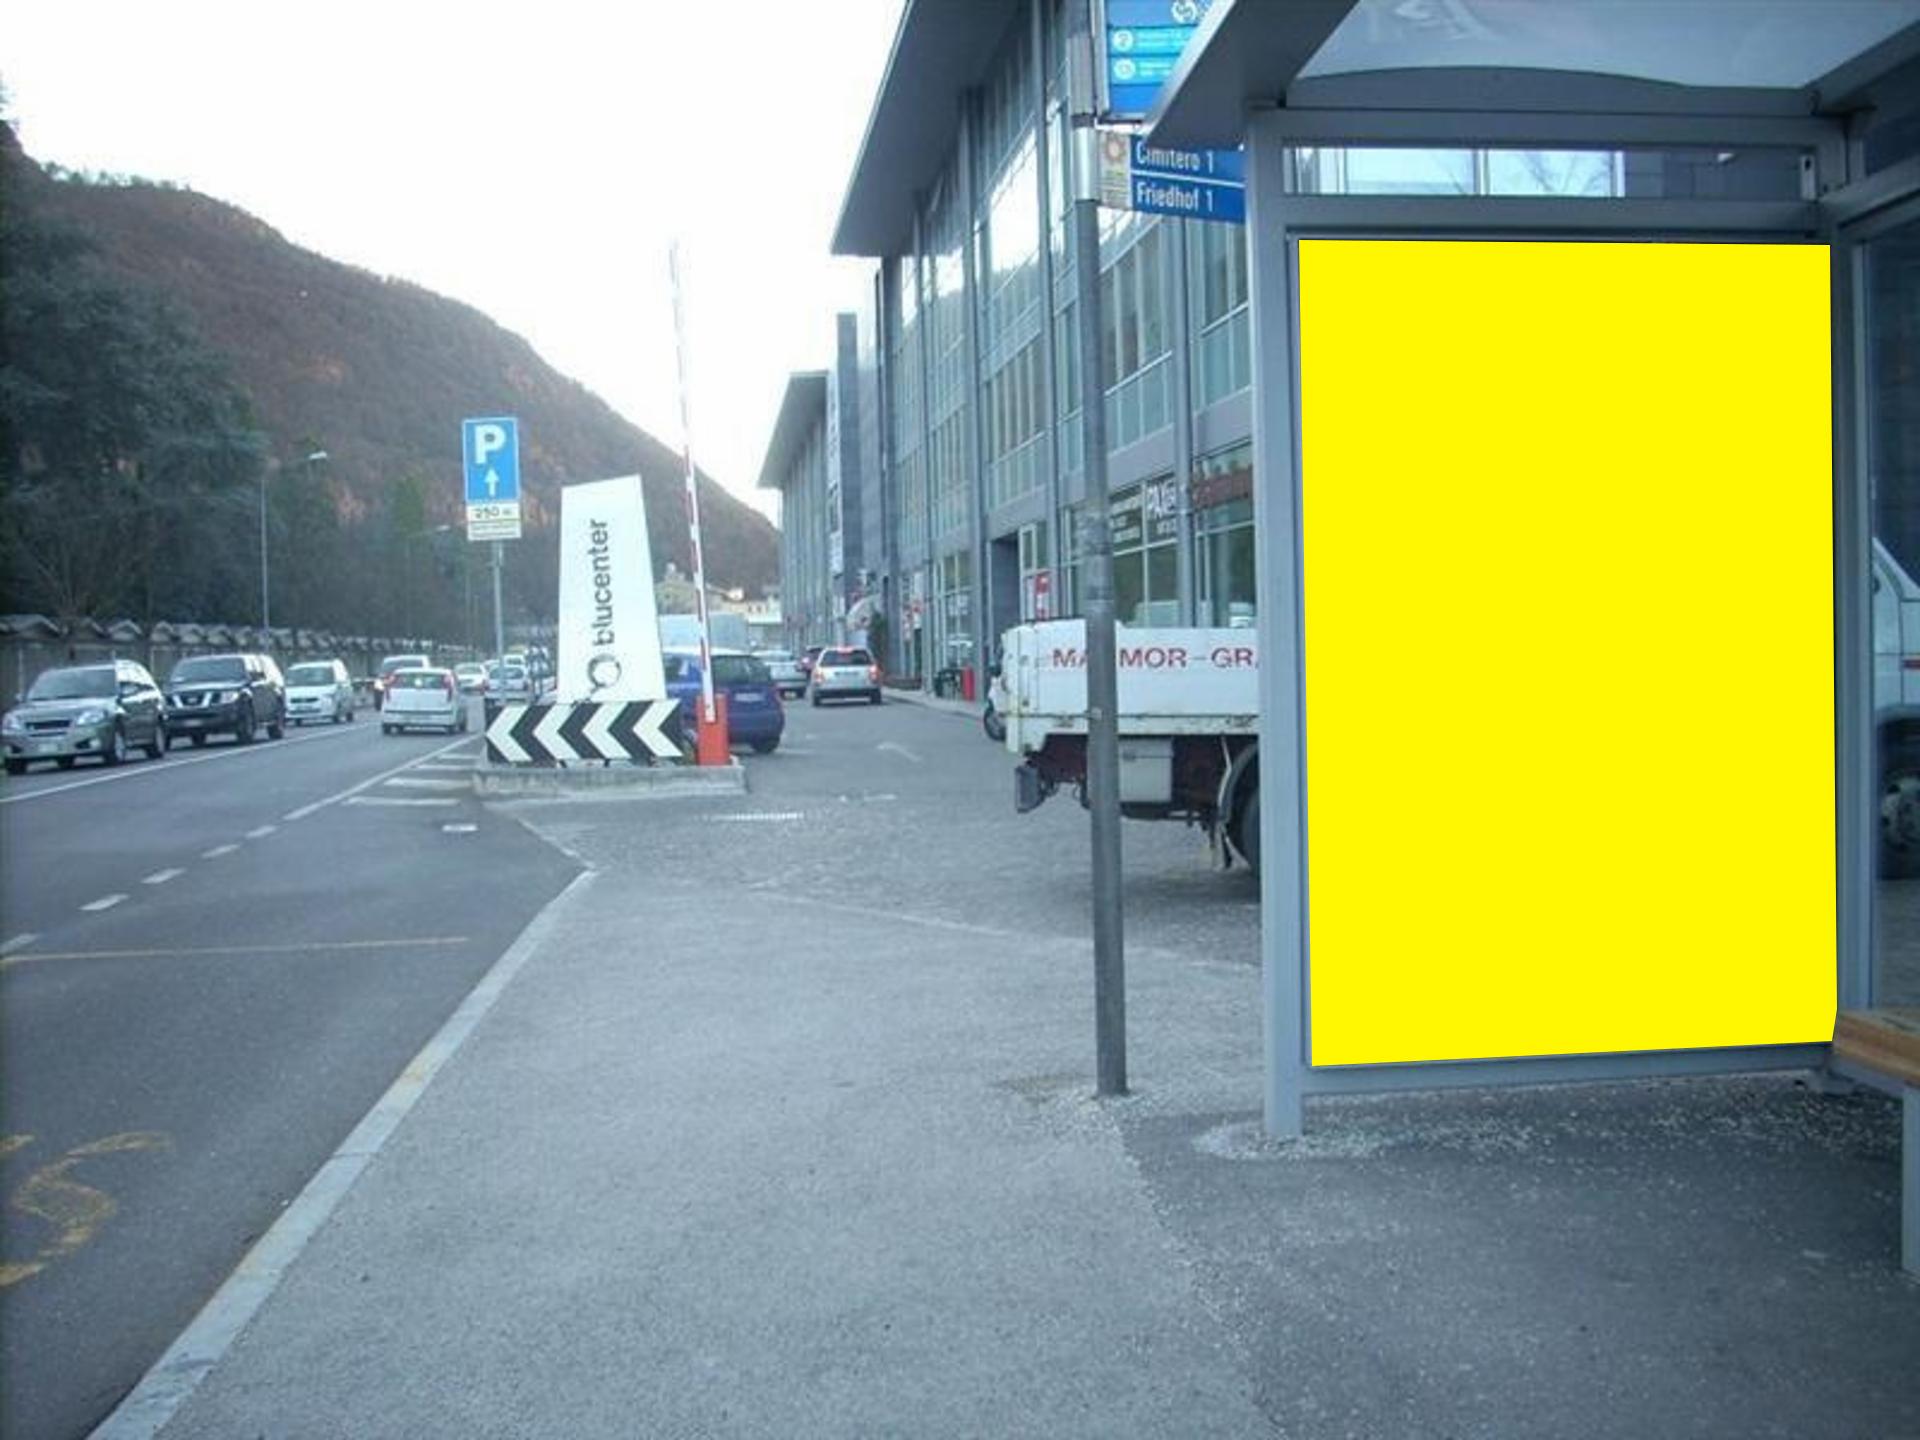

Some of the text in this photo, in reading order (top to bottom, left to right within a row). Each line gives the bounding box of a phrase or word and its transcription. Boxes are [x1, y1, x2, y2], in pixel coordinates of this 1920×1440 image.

[1136, 141, 1214, 173] Cimitero 1
[1136, 181, 1199, 212] Friedhof
[1206, 189, 1214, 213] 1
[475, 424, 506, 464] P
[587, 518, 614, 646] blucenter
